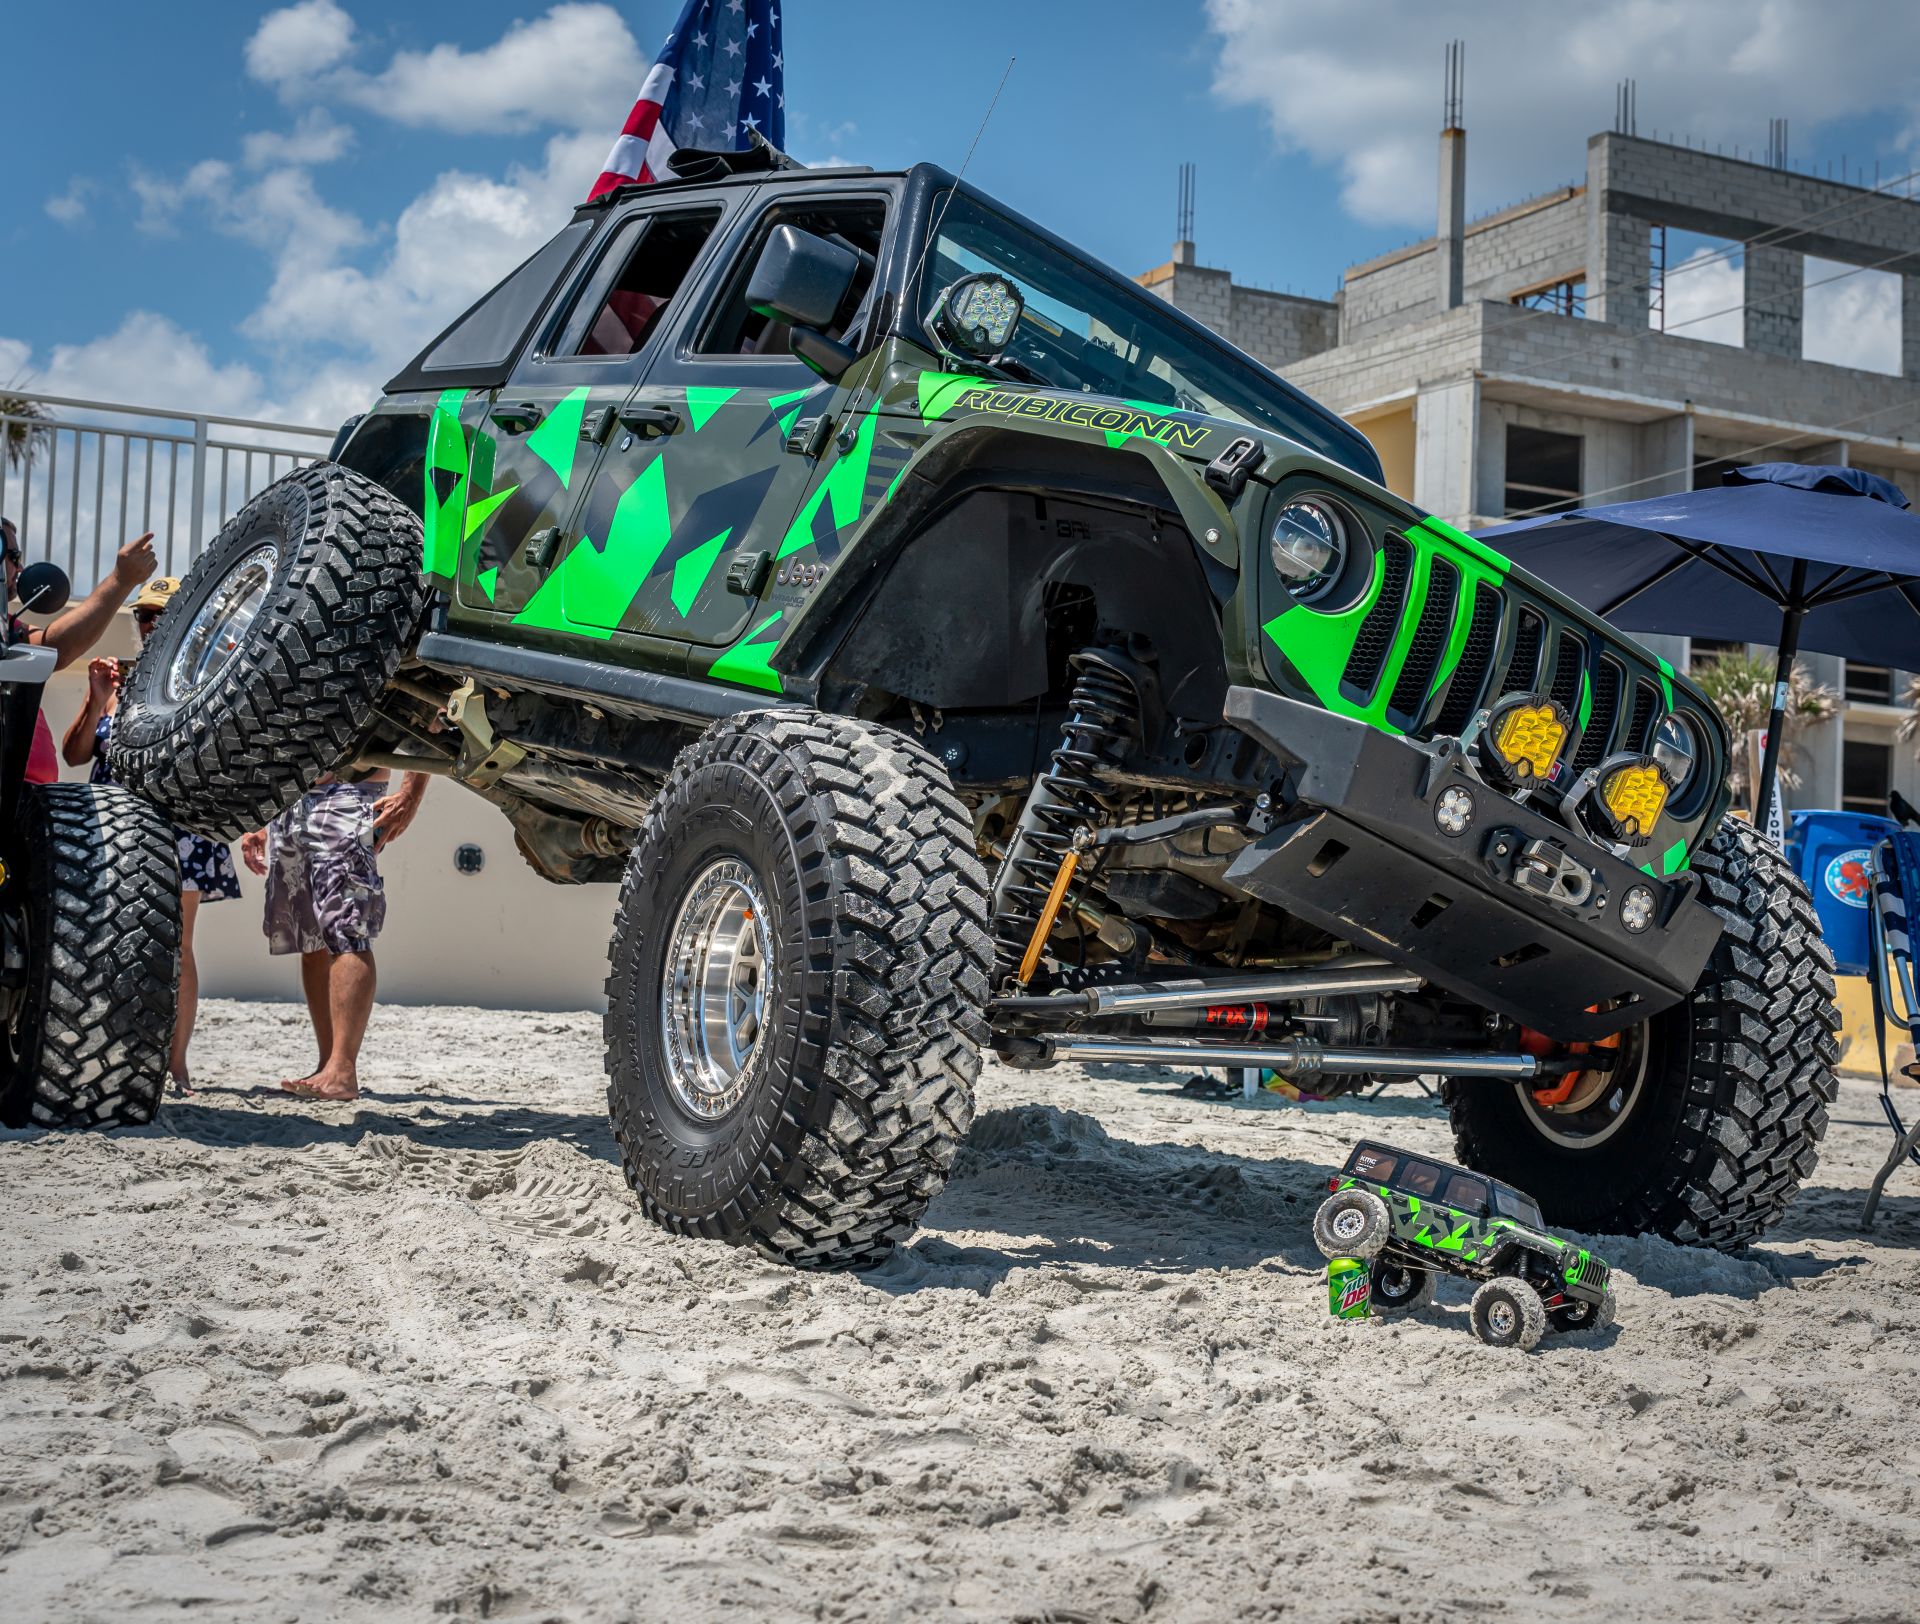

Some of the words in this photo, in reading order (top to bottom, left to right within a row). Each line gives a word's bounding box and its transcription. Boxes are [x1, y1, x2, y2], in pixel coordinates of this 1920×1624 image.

[953, 388, 1213, 448] RUBICONN
[776, 556, 830, 593] Jeep
[990, 860, 1006, 891] COUNT
[1206, 1005, 1247, 1026] FOX
